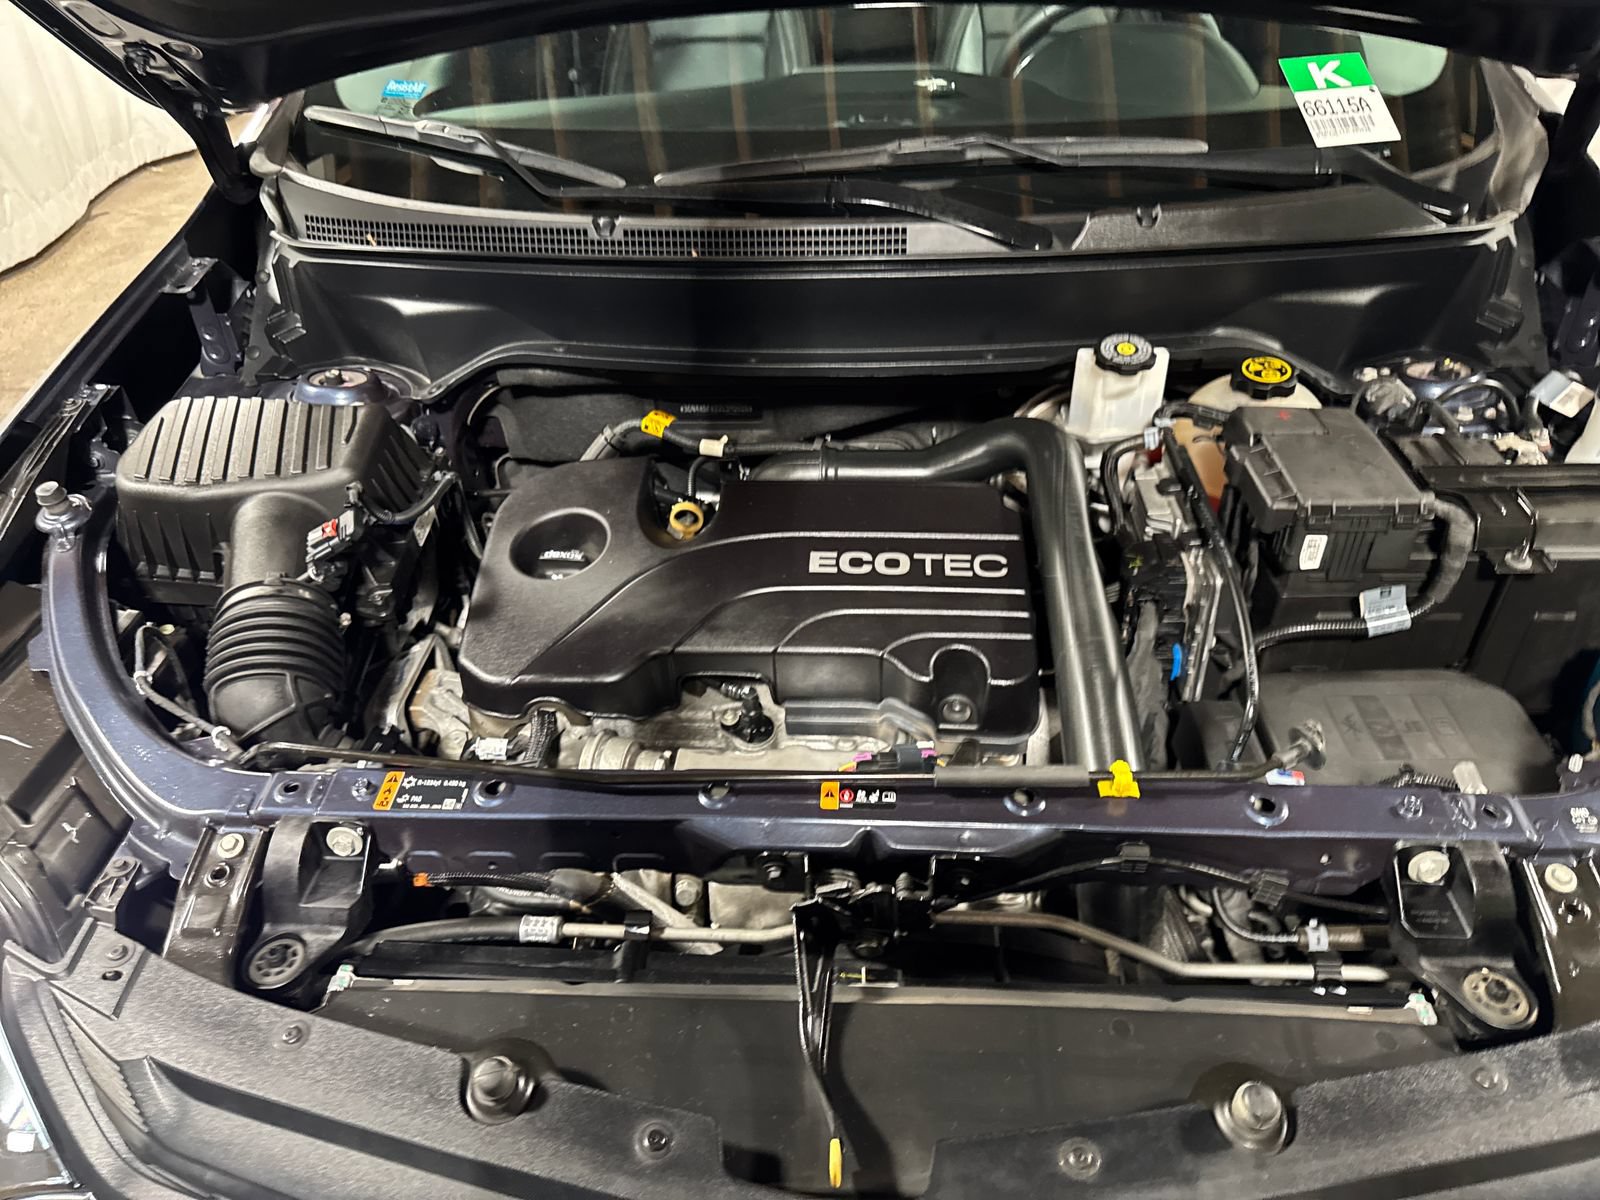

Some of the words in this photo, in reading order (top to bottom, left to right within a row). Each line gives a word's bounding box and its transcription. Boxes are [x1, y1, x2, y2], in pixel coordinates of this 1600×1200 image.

[1307, 59, 1353, 90] K
[1302, 96, 1373, 118] 66115A
[808, 550, 1009, 578] ECOTEC
